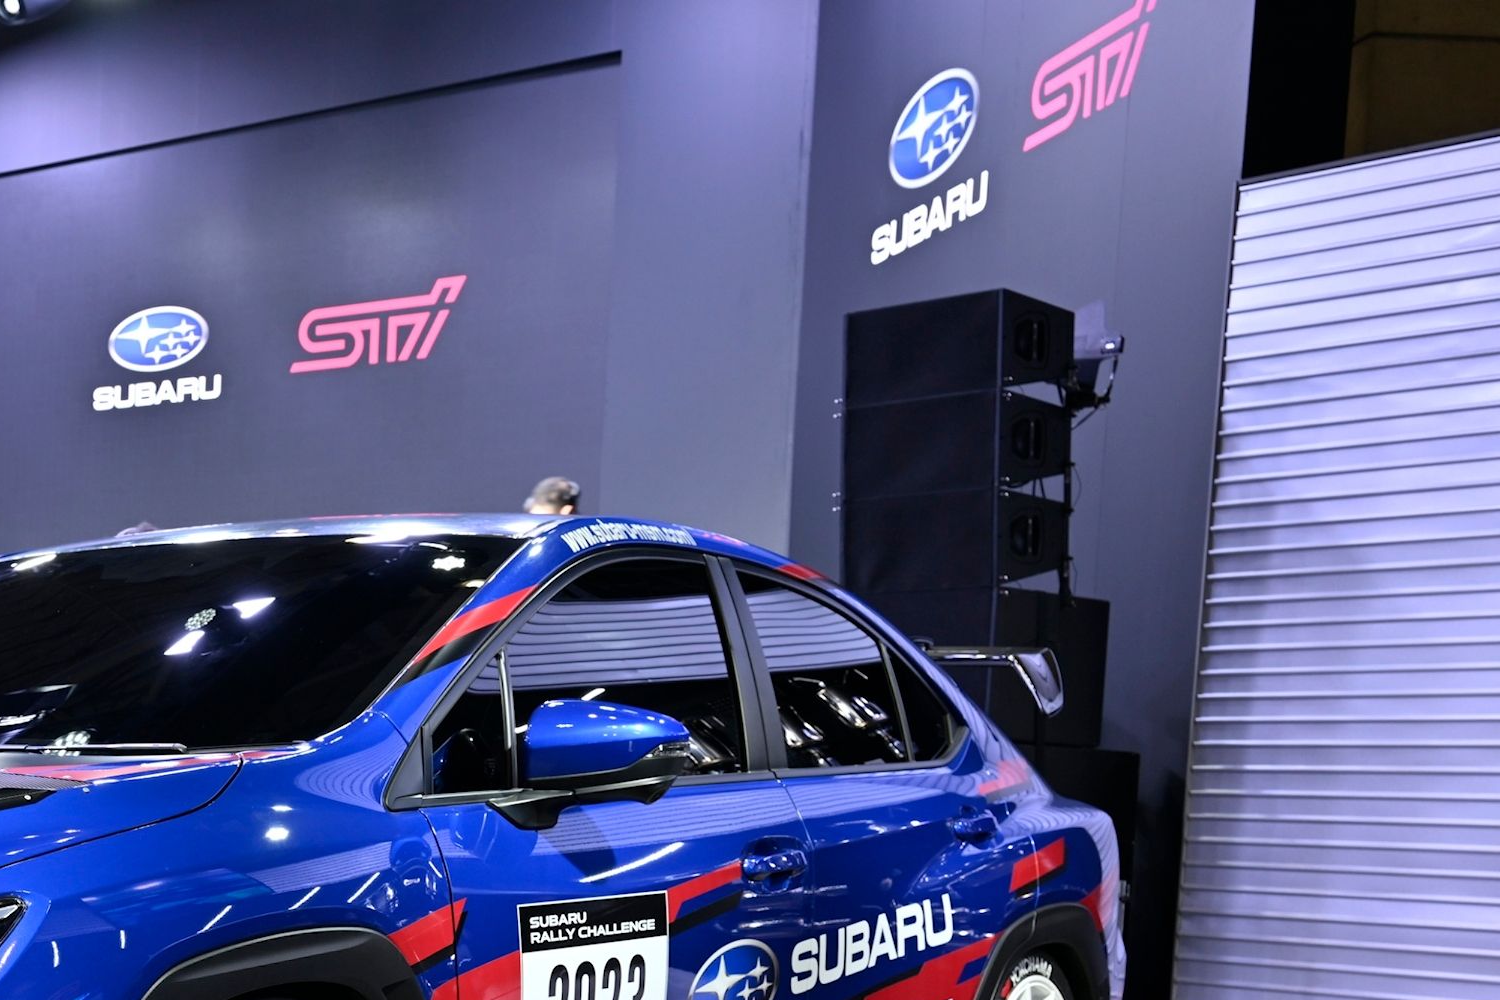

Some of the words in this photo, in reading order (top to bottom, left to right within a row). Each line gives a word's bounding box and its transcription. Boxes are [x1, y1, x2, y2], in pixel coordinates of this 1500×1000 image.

[870, 169, 989, 265] SUBARU
[92, 374, 222, 411] SUBARU
[529, 911, 587, 929] SUBARU
[530, 928, 577, 944] RALLY
[578, 918, 656, 939] CHALLENGE
[790, 893, 954, 995] SUBARU
[1010, 956, 1053, 988] YOKOHAMA
